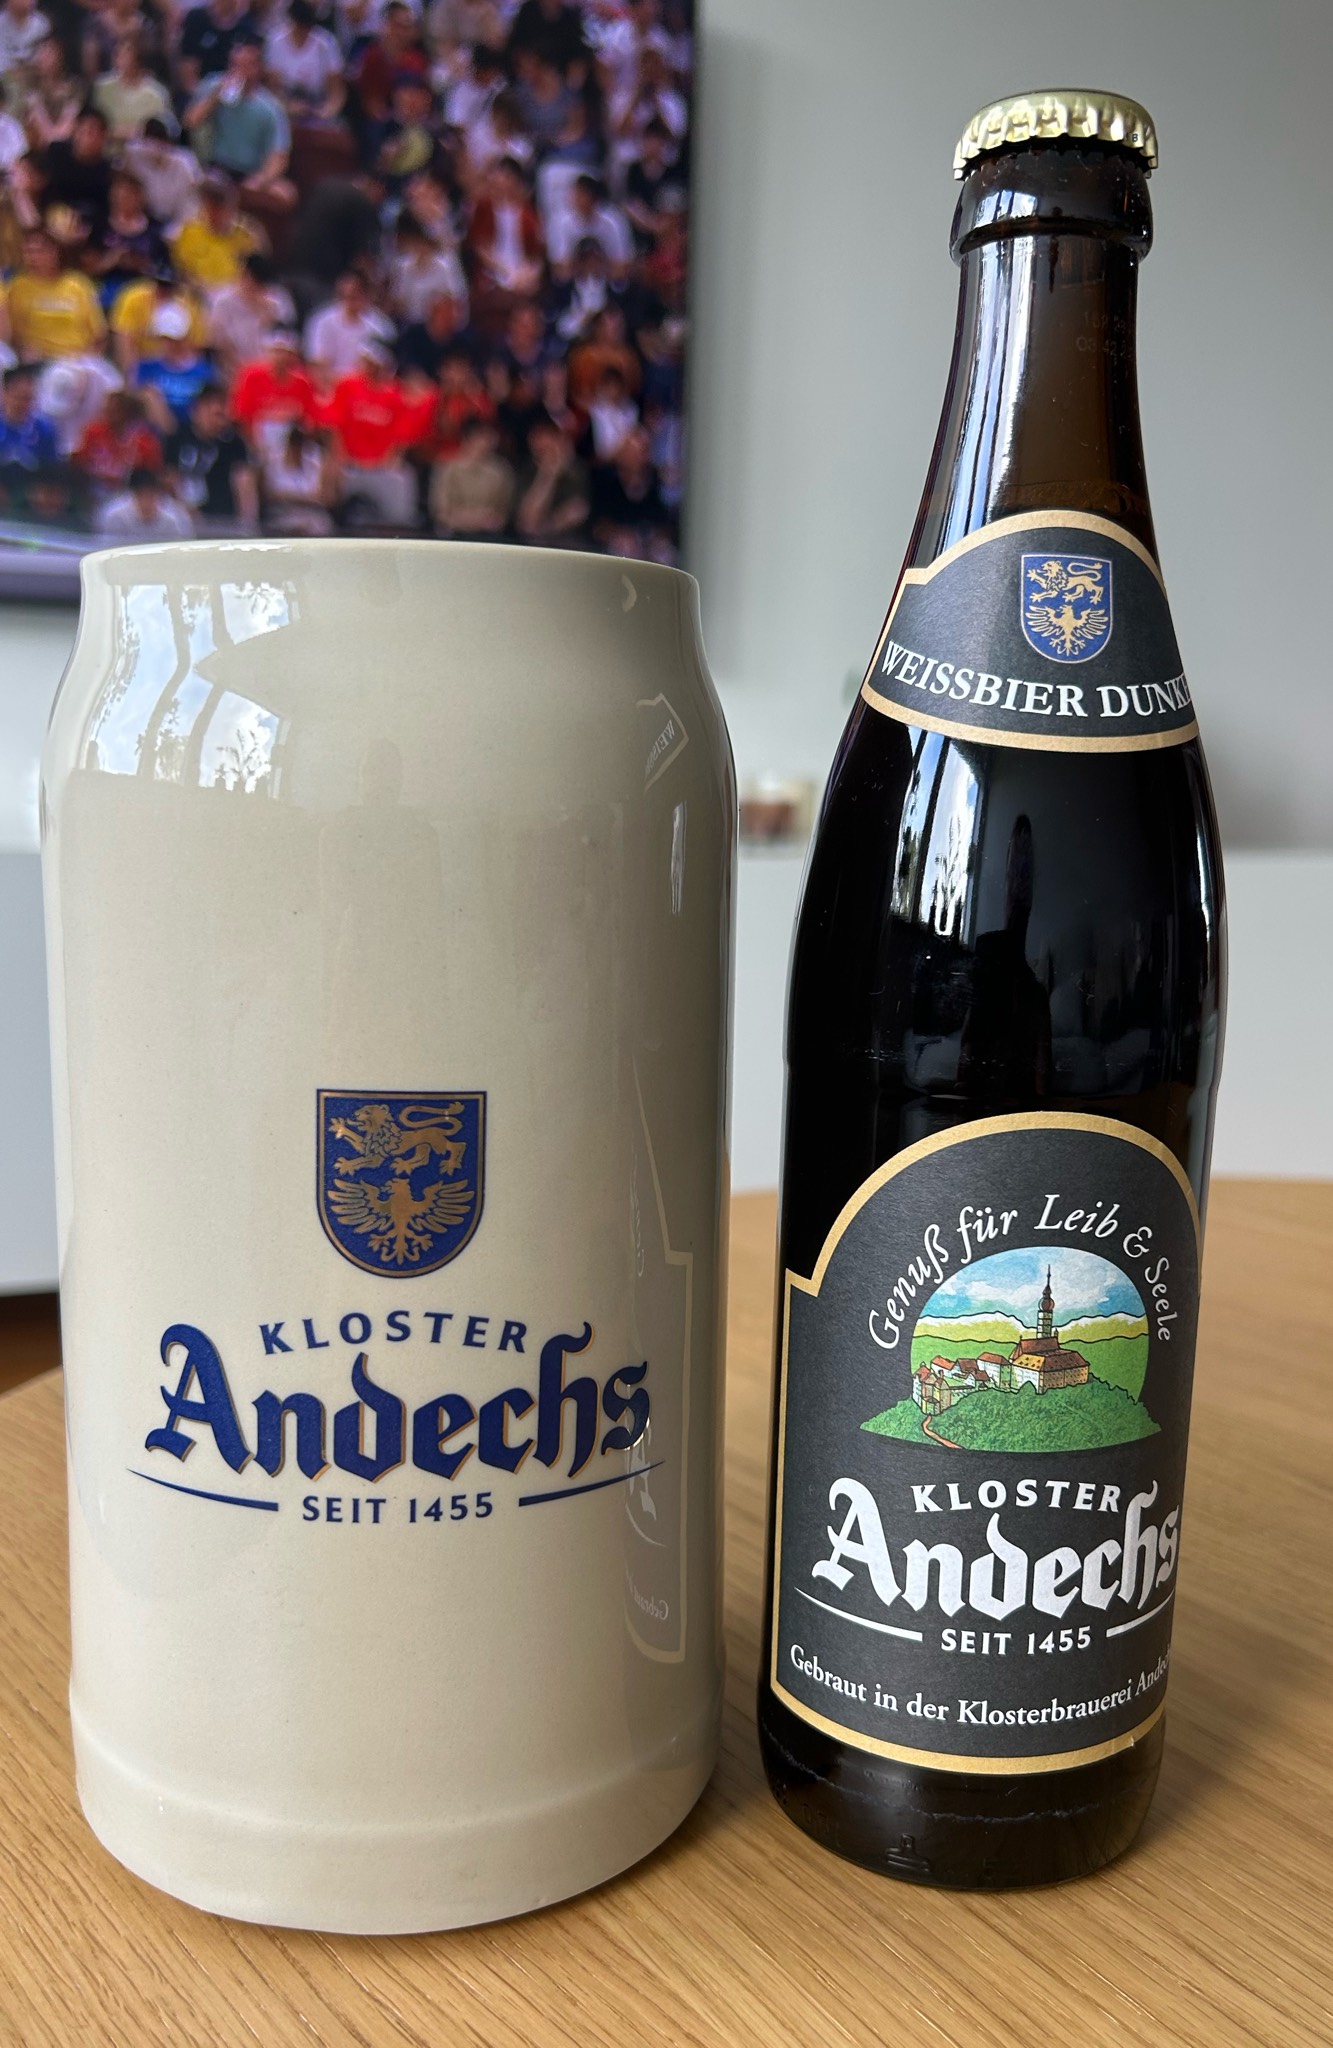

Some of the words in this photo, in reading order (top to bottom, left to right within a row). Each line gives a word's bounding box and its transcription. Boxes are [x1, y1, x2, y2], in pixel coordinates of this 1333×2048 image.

[881, 640, 1088, 718] WEISSBIER
[868, 1223, 949, 1350] Genuß
[956, 1205, 1018, 1264] für
[1033, 1194, 1120, 1238] Leib
[1122, 1225, 1153, 1259] &
[1144, 1256, 1178, 1342] Seele
[259, 1310, 528, 1356] KLOSTER
[144, 1320, 650, 1484] Andechs
[301, 1494, 387, 1524] SEIT
[408, 1491, 494, 1523] 1455
[910, 1478, 1122, 1514] KLOSTER
[811, 1477, 1180, 1620] Andechs
[940, 1628, 1012, 1656] SEIT
[1027, 1625, 1092, 1655] 1455
[789, 1643, 868, 1702] Gebraut
[873, 1683, 899, 1712] in
[906, 1692, 950, 1721] der
[956, 1678, 1133, 1727] Klosterbrauerei
